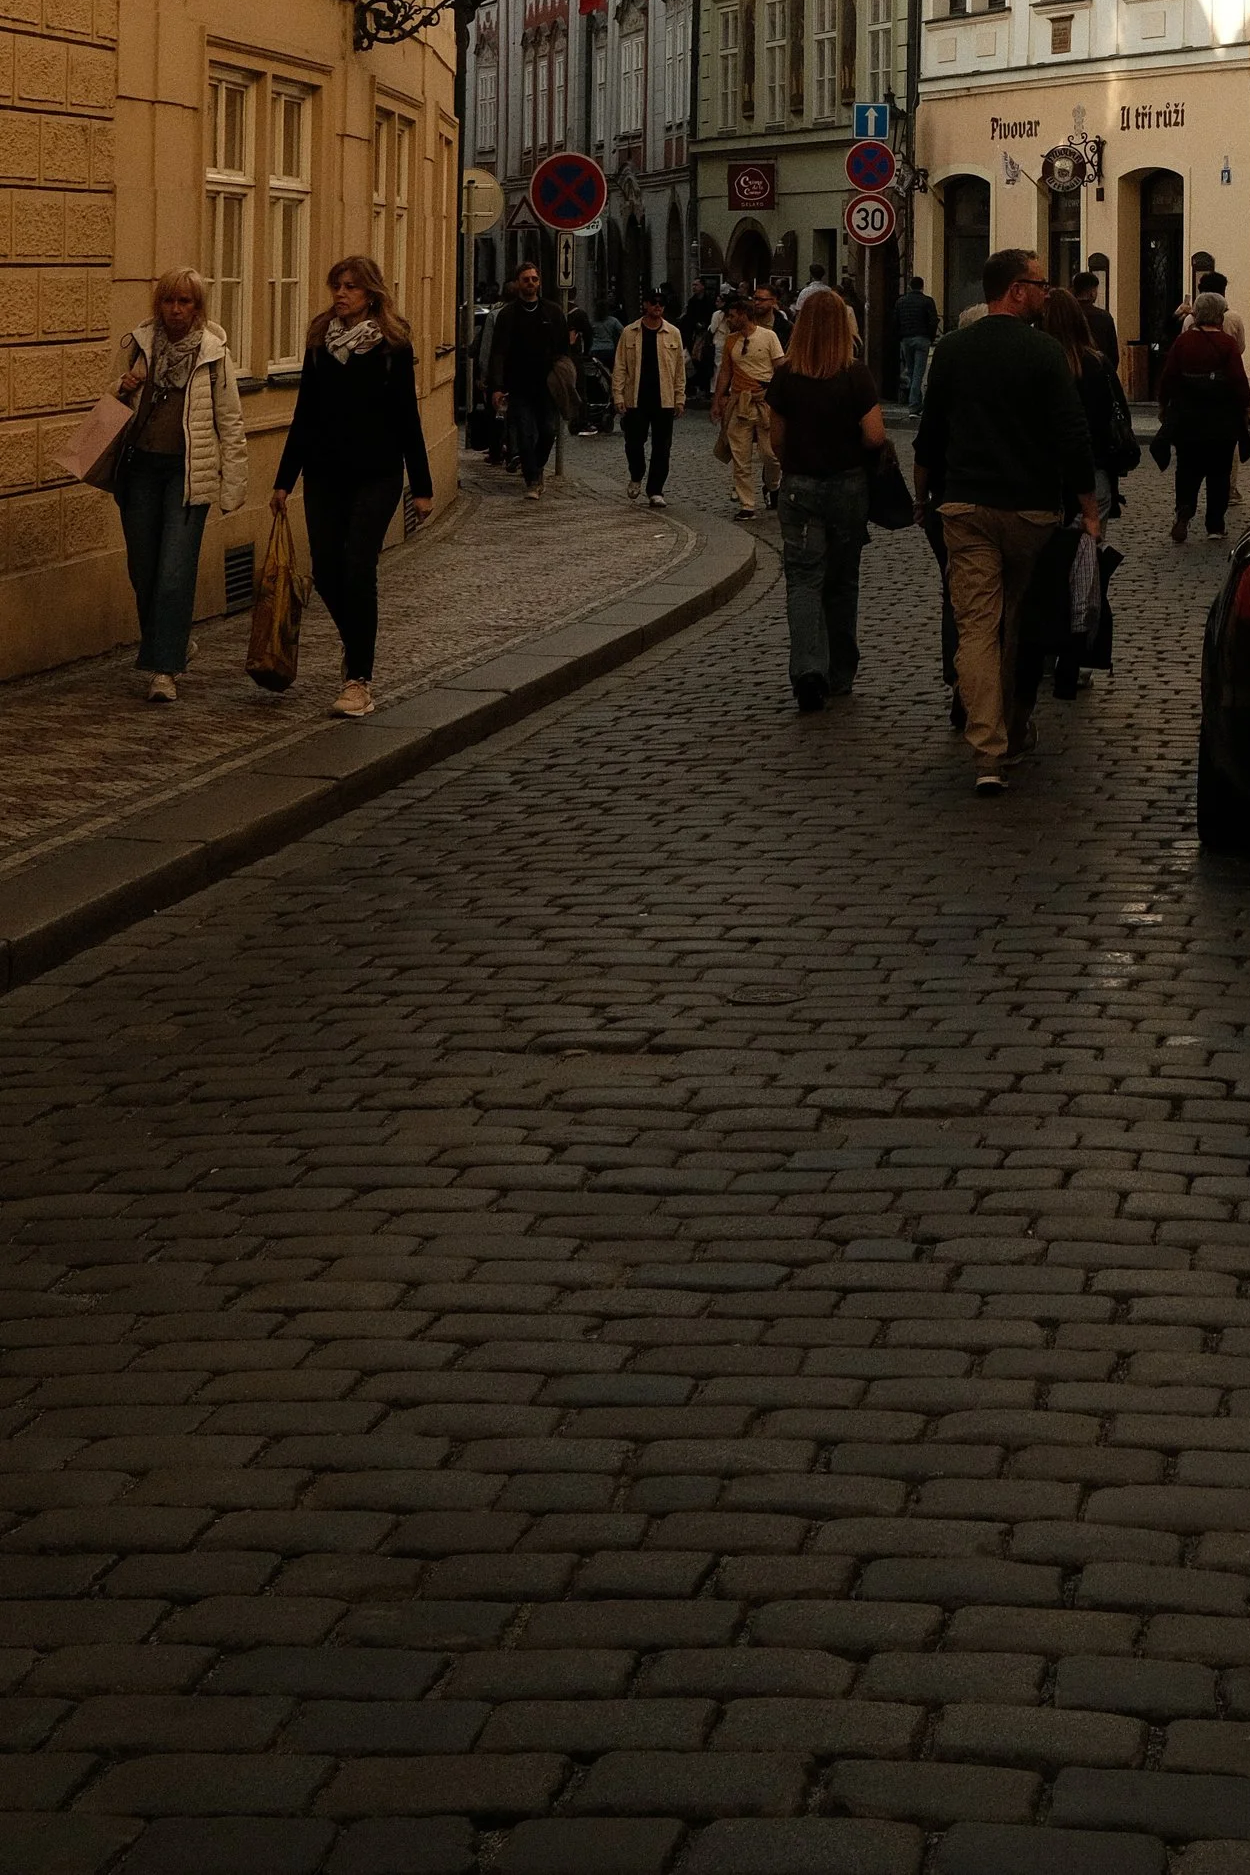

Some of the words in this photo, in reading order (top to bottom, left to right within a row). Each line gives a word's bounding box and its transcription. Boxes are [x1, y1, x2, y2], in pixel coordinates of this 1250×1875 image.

[990, 116, 1041, 141] Pivovar
[1135, 104, 1152, 130] tří
[1155, 102, 1185, 129] růží
[856, 207, 885, 231] 30
